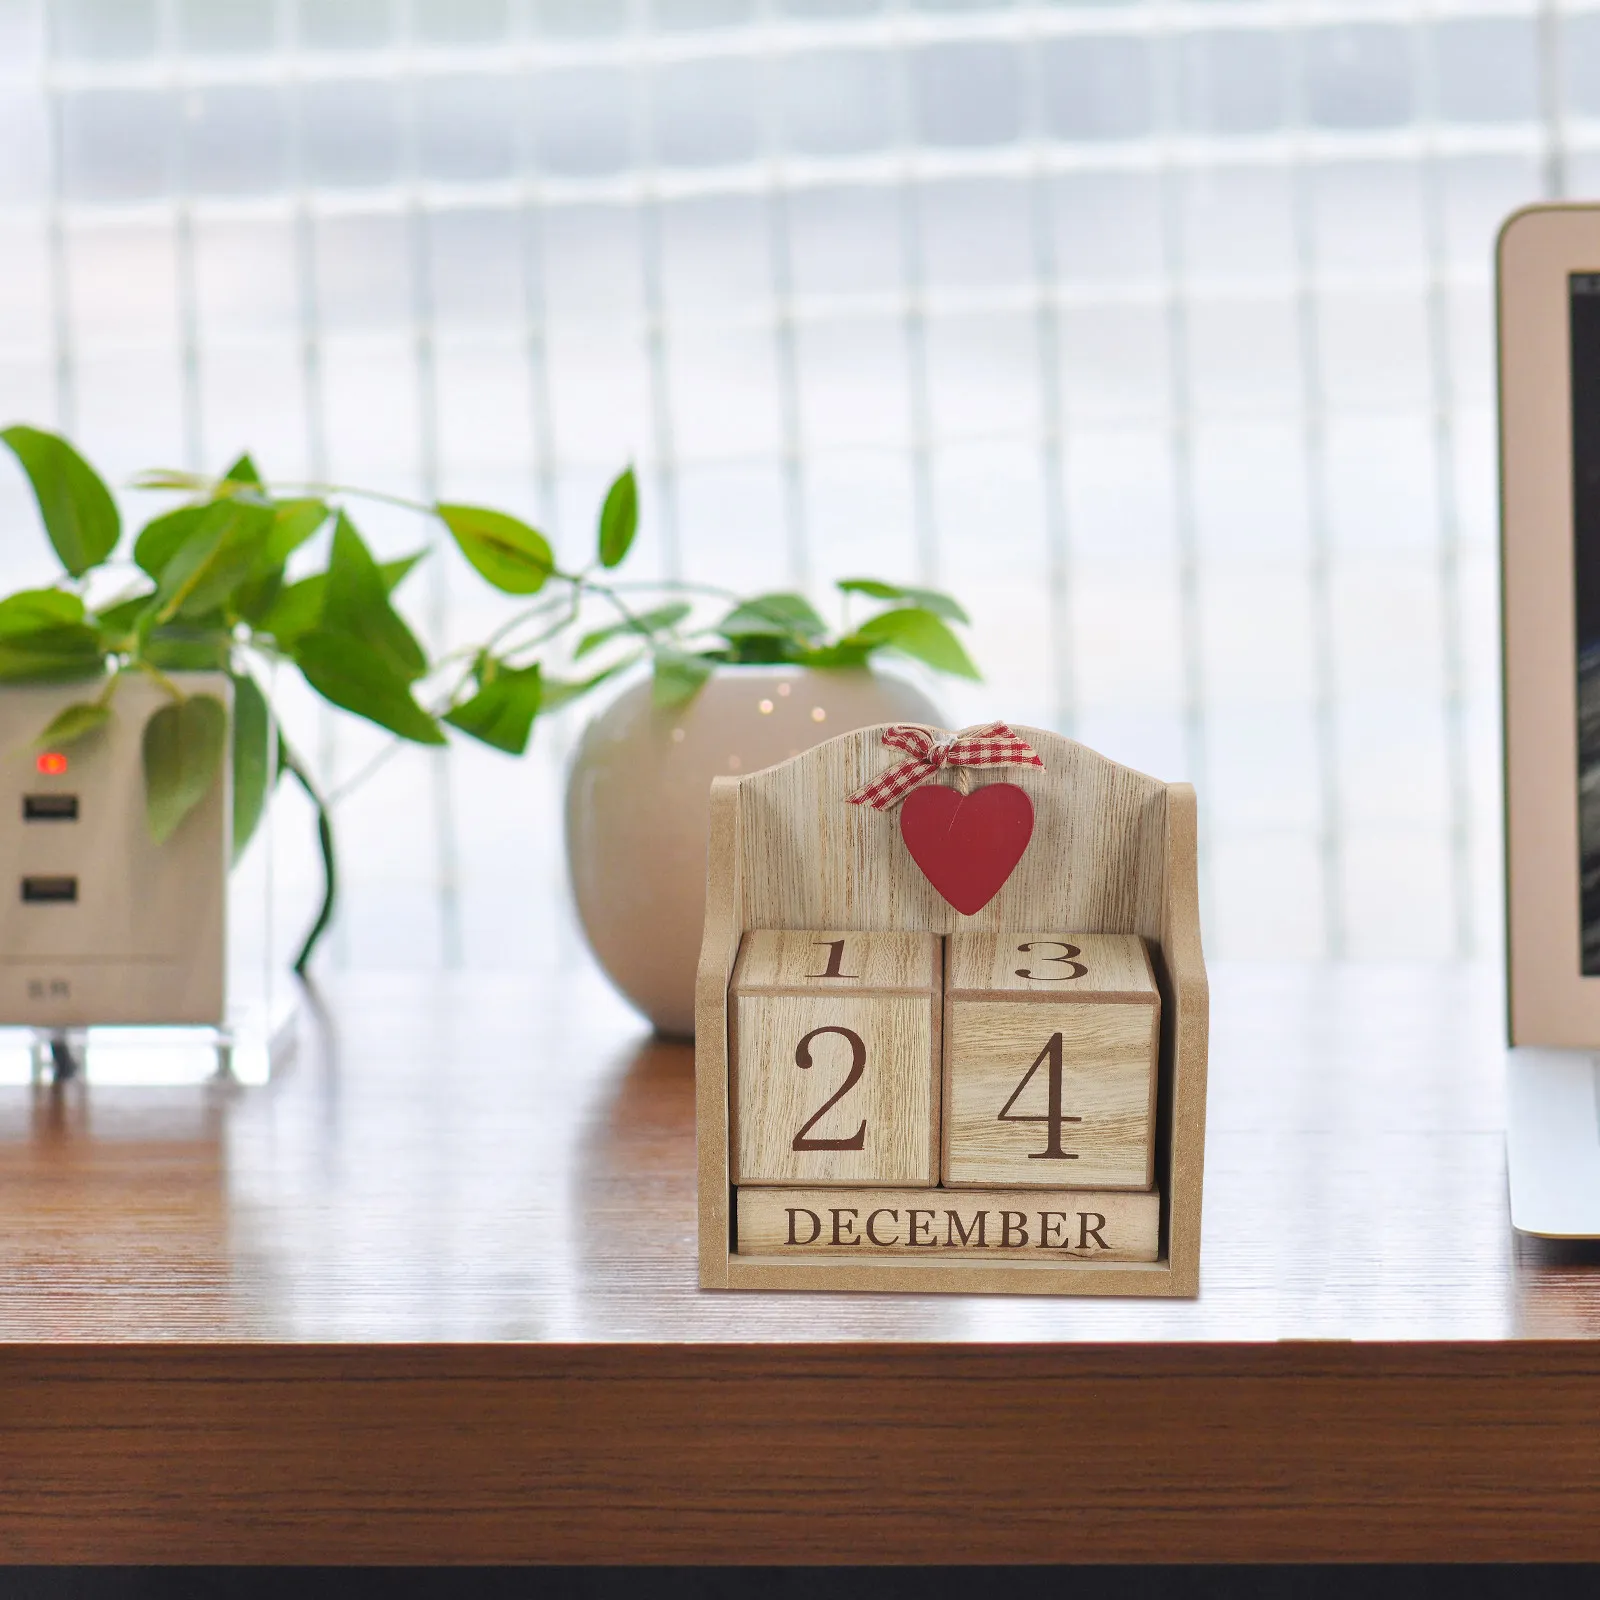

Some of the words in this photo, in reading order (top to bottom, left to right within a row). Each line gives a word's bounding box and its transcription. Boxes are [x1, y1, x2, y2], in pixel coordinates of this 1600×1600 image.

[805, 940, 859, 978] 1
[1014, 941, 1088, 981] 3
[792, 1026, 867, 1151] 2
[998, 1032, 1082, 1160] 4
[784, 1208, 1112, 1250] DECEMBER
